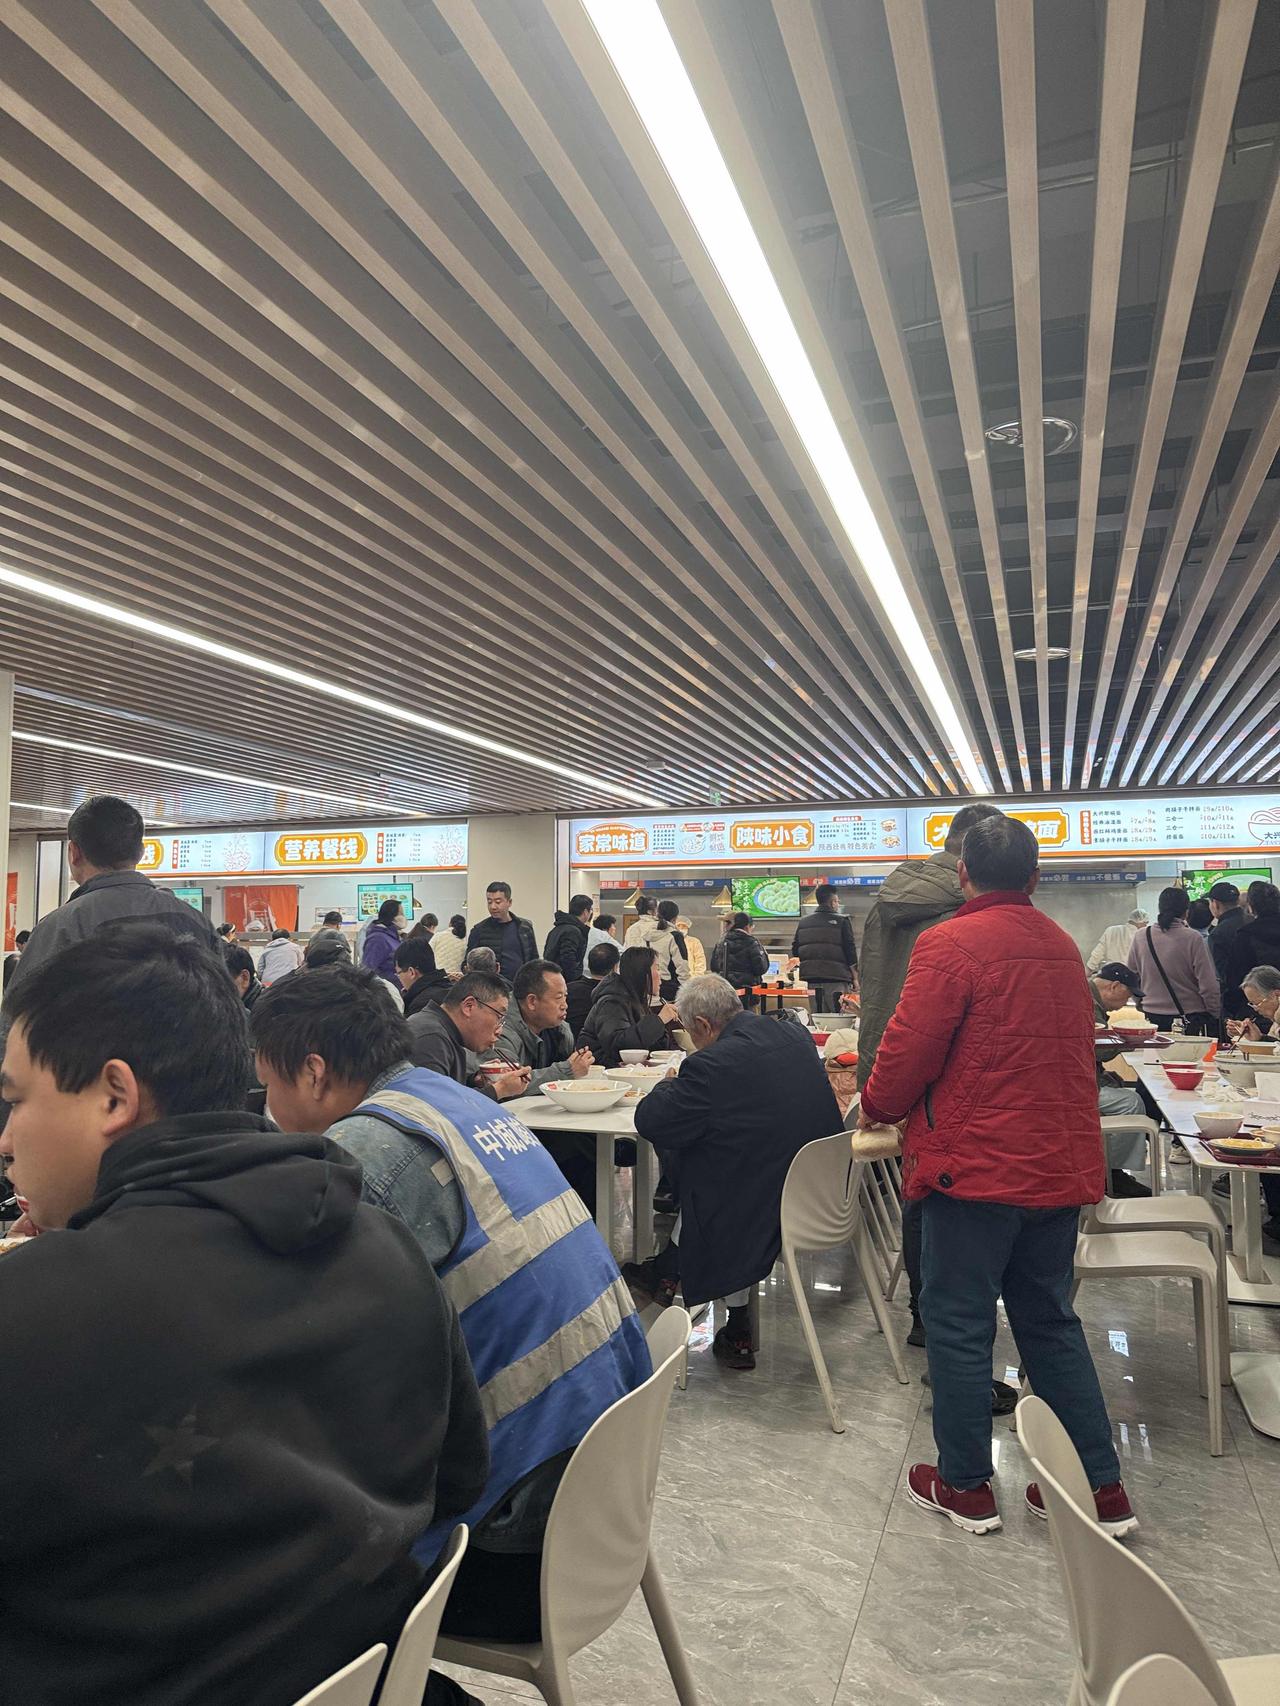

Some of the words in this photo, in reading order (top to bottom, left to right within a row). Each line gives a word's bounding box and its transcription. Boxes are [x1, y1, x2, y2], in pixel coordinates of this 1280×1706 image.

[578, 832, 646, 853] 家常味道
[736, 825, 809, 847] 陕味小食
[284, 838, 358, 861] 营养餐线
